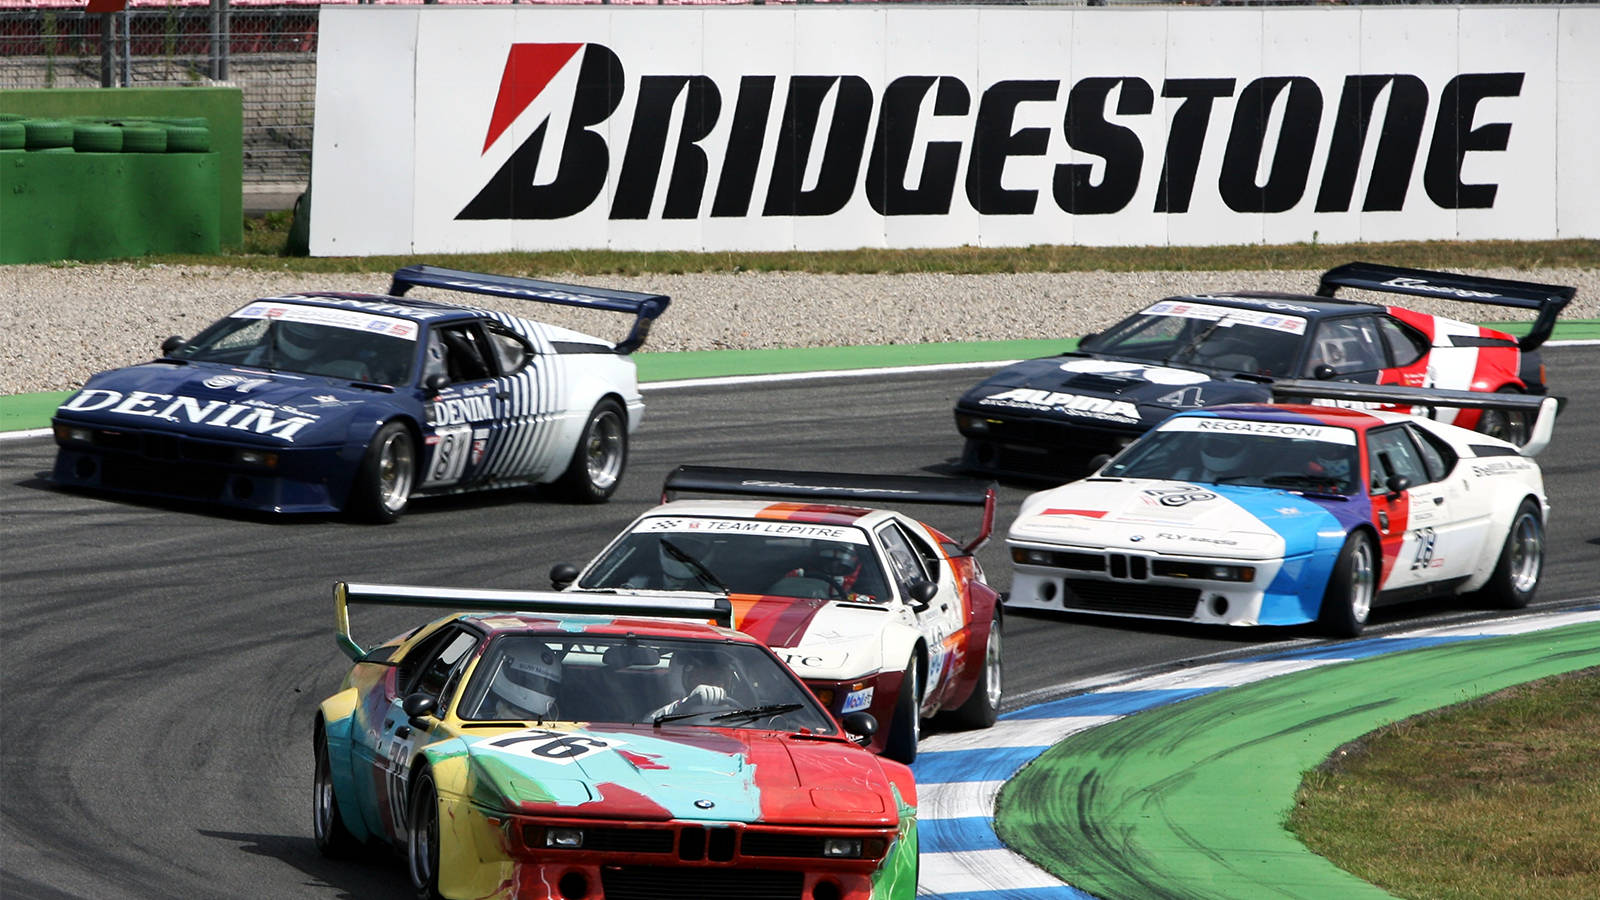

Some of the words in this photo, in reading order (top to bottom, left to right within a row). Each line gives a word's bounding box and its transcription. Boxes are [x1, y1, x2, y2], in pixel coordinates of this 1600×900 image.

[454, 43, 1524, 220] BRIDGESTONE
[58, 389, 316, 443] DENIM
[432, 396, 494, 427] DENIM
[984, 388, 1142, 420] ALPINA
[1198, 420, 1323, 438] REGAZZONI
[707, 521, 759, 531] TEAM
[764, 524, 846, 538] LEPITRE
[488, 729, 608, 759] 76
